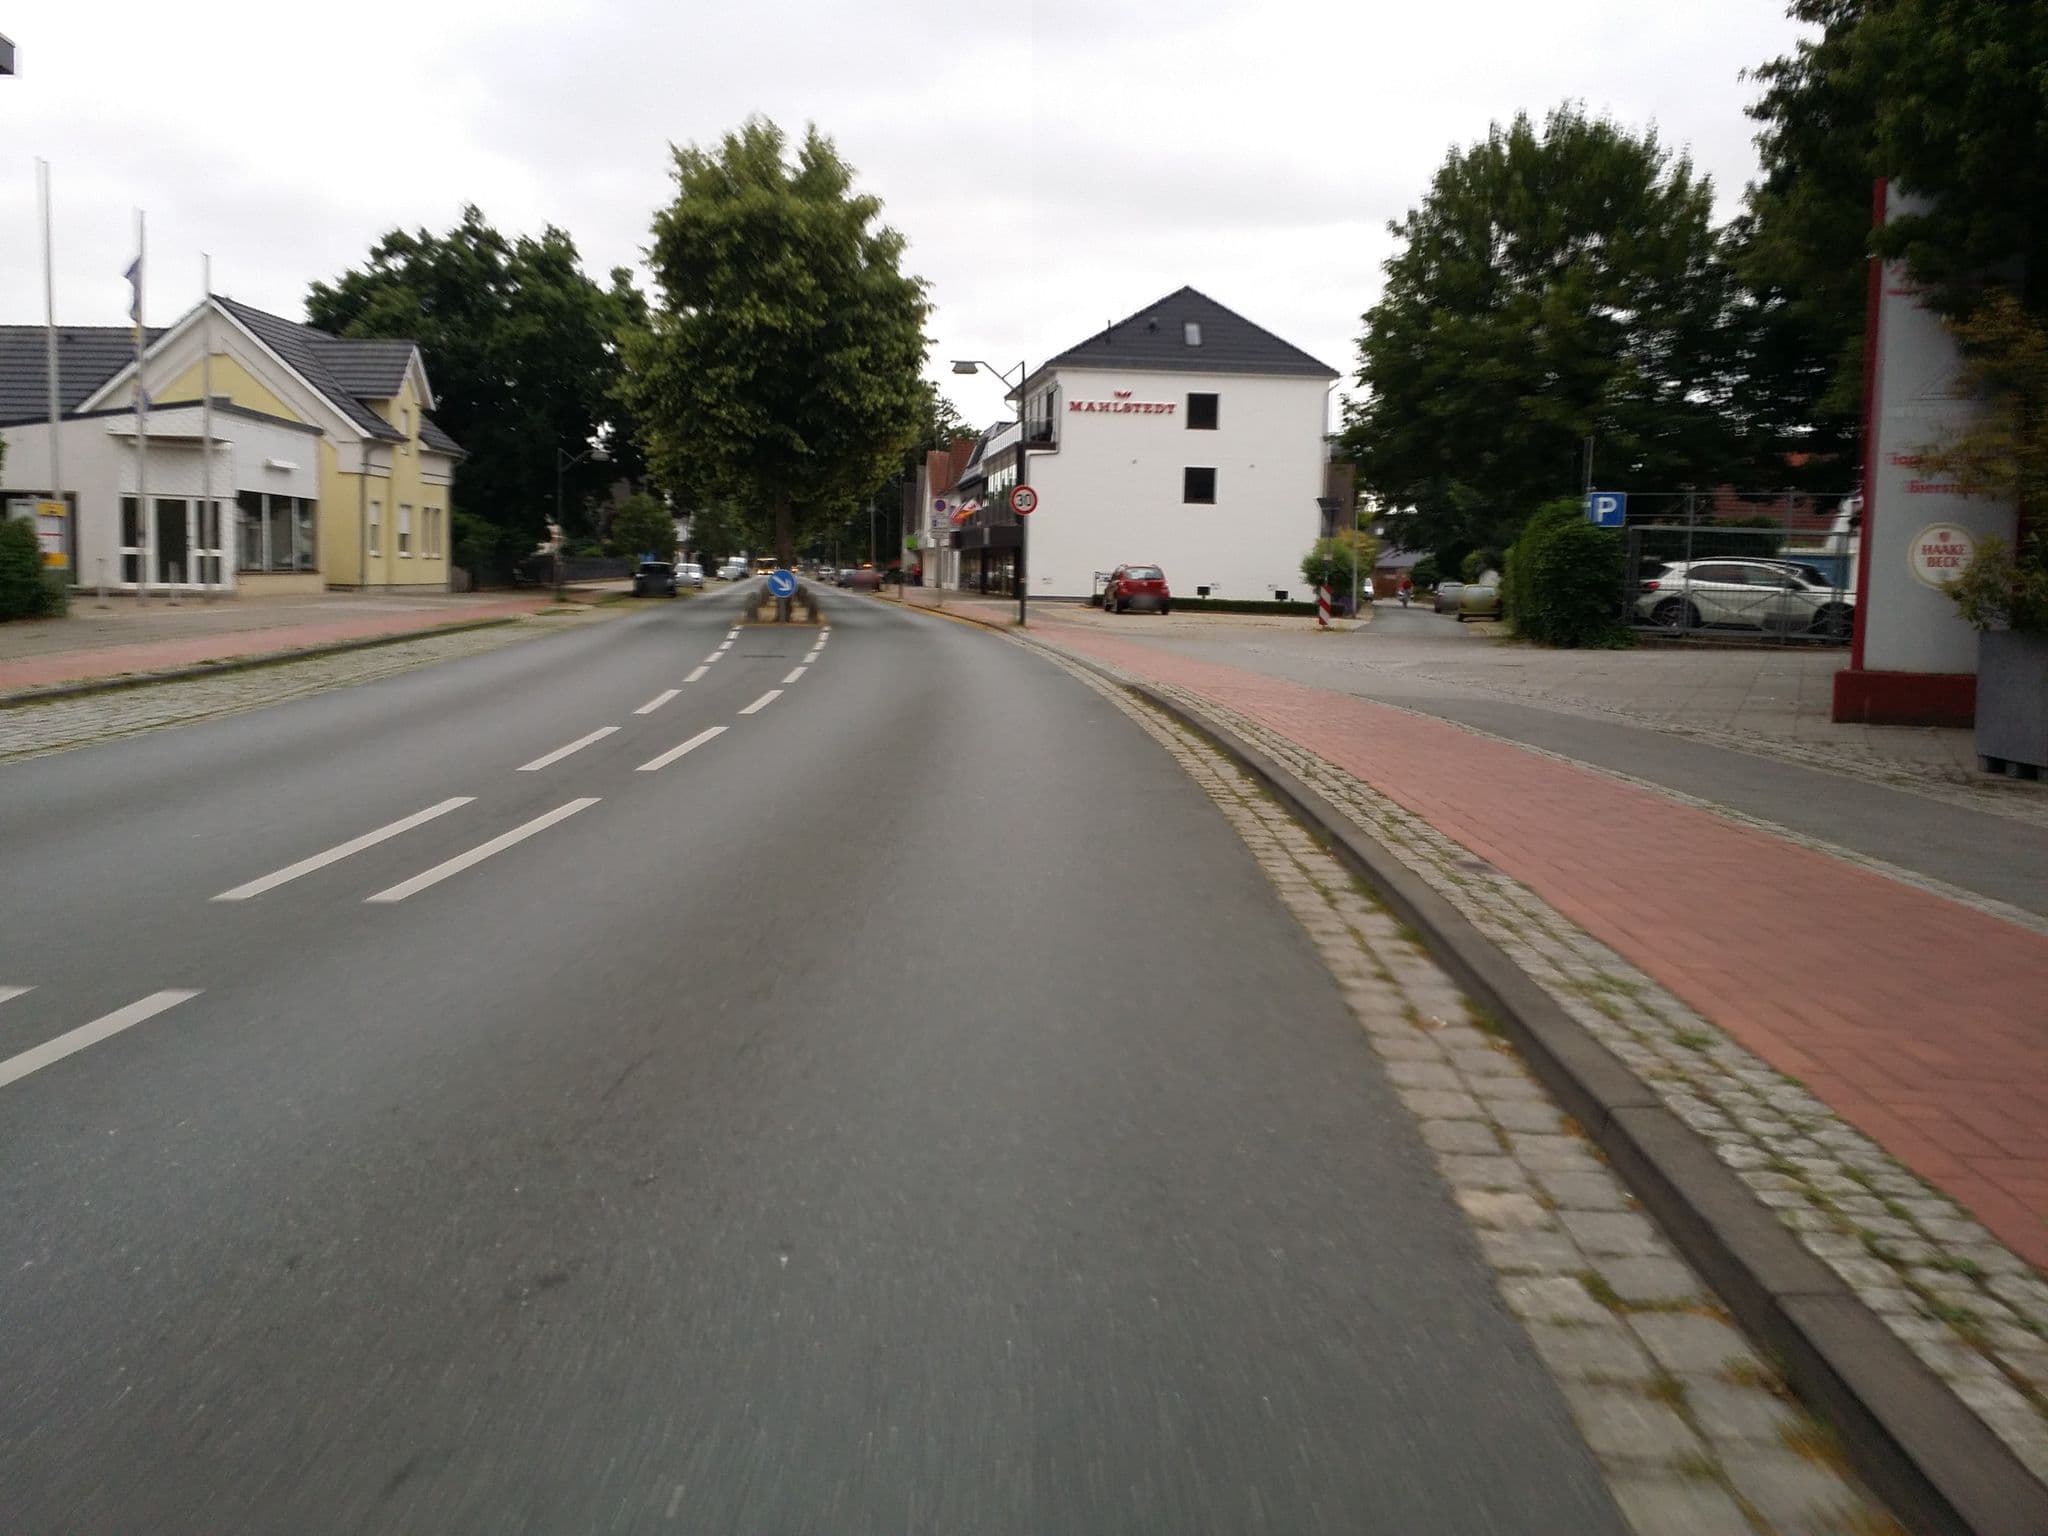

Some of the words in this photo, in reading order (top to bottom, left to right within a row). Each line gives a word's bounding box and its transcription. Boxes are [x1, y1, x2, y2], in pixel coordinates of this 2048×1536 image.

[1069, 400, 1177, 414] MAHLSTEDT
[1016, 493, 1032, 507] 30
[1593, 497, 1617, 522] P
[1926, 556, 1960, 568] BECK
